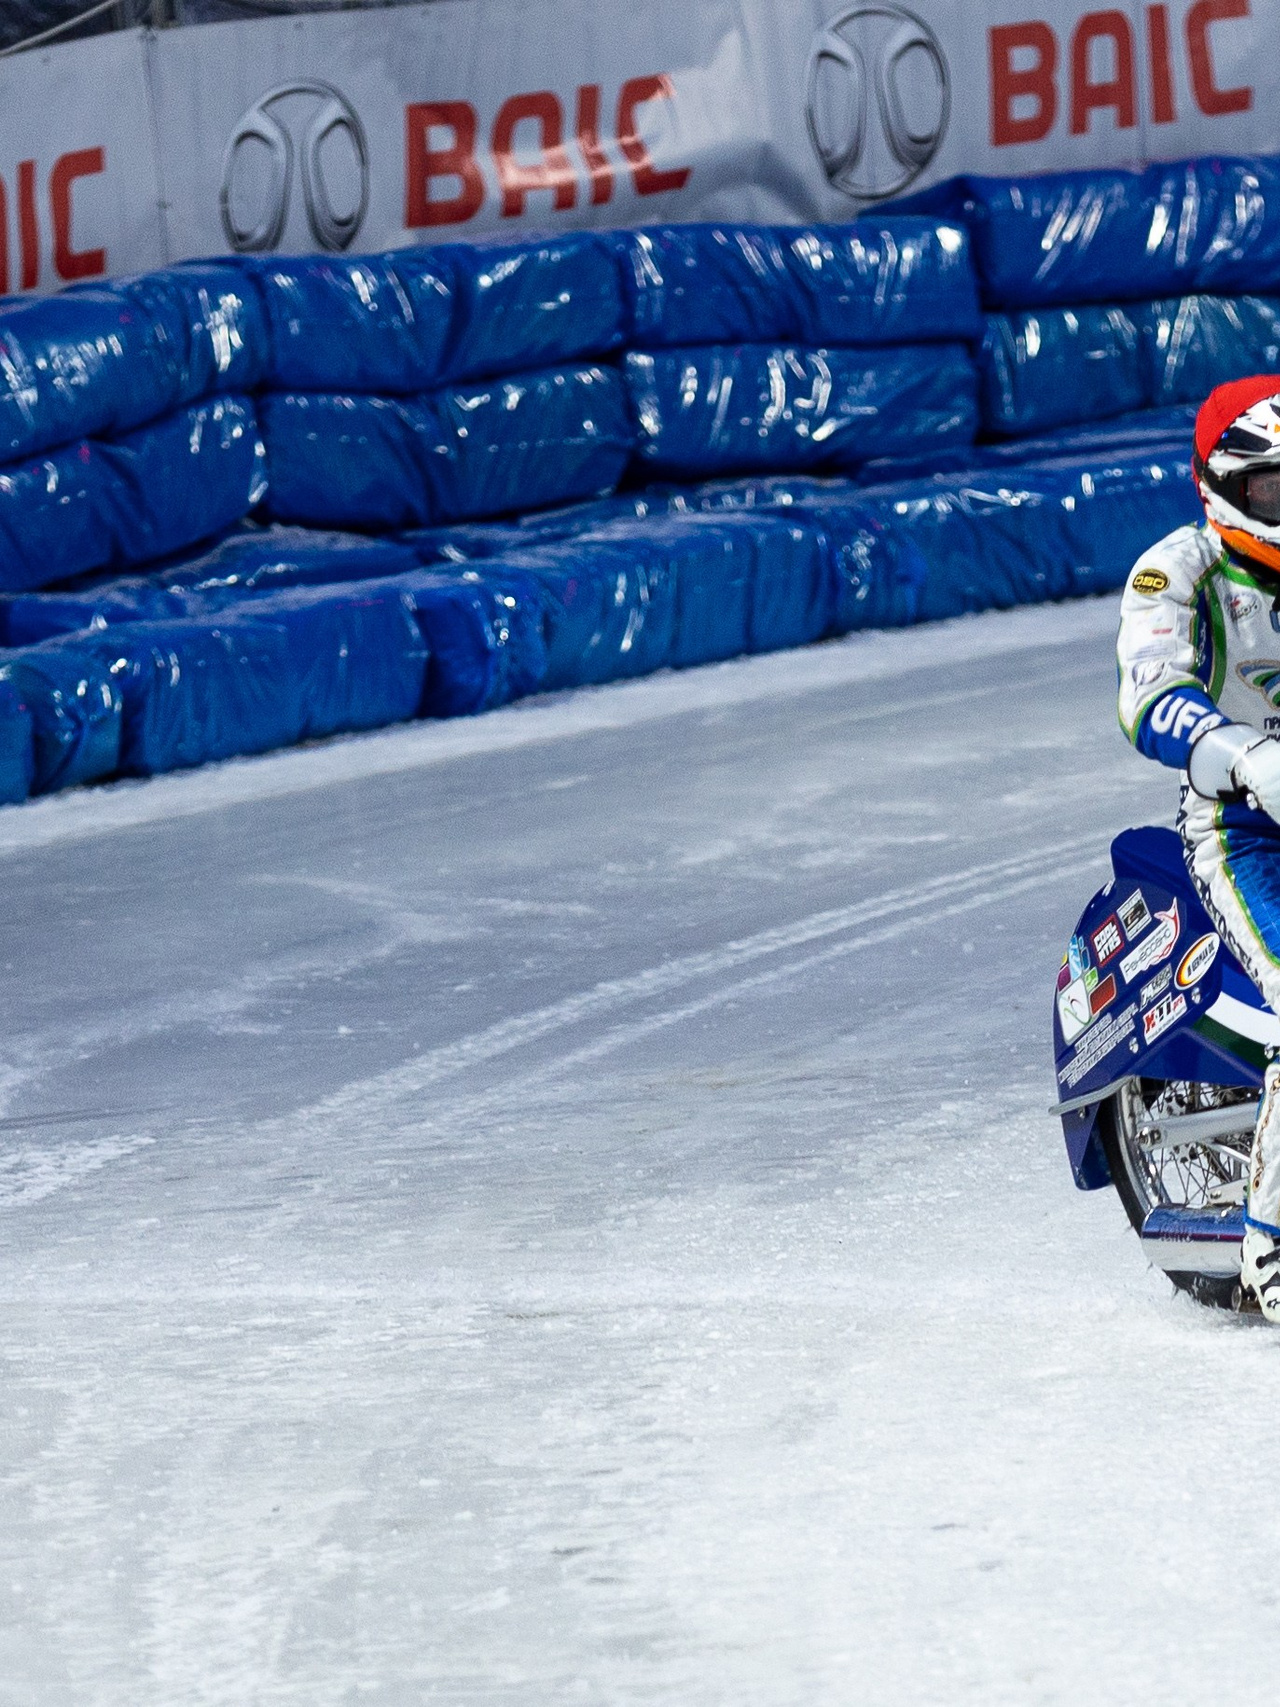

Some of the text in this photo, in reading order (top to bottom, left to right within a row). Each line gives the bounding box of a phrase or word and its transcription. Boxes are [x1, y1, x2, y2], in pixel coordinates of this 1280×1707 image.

[986, 0, 1252, 147] BAIC
[0, 146, 105, 296] IC
[405, 73, 695, 229] BAIC
